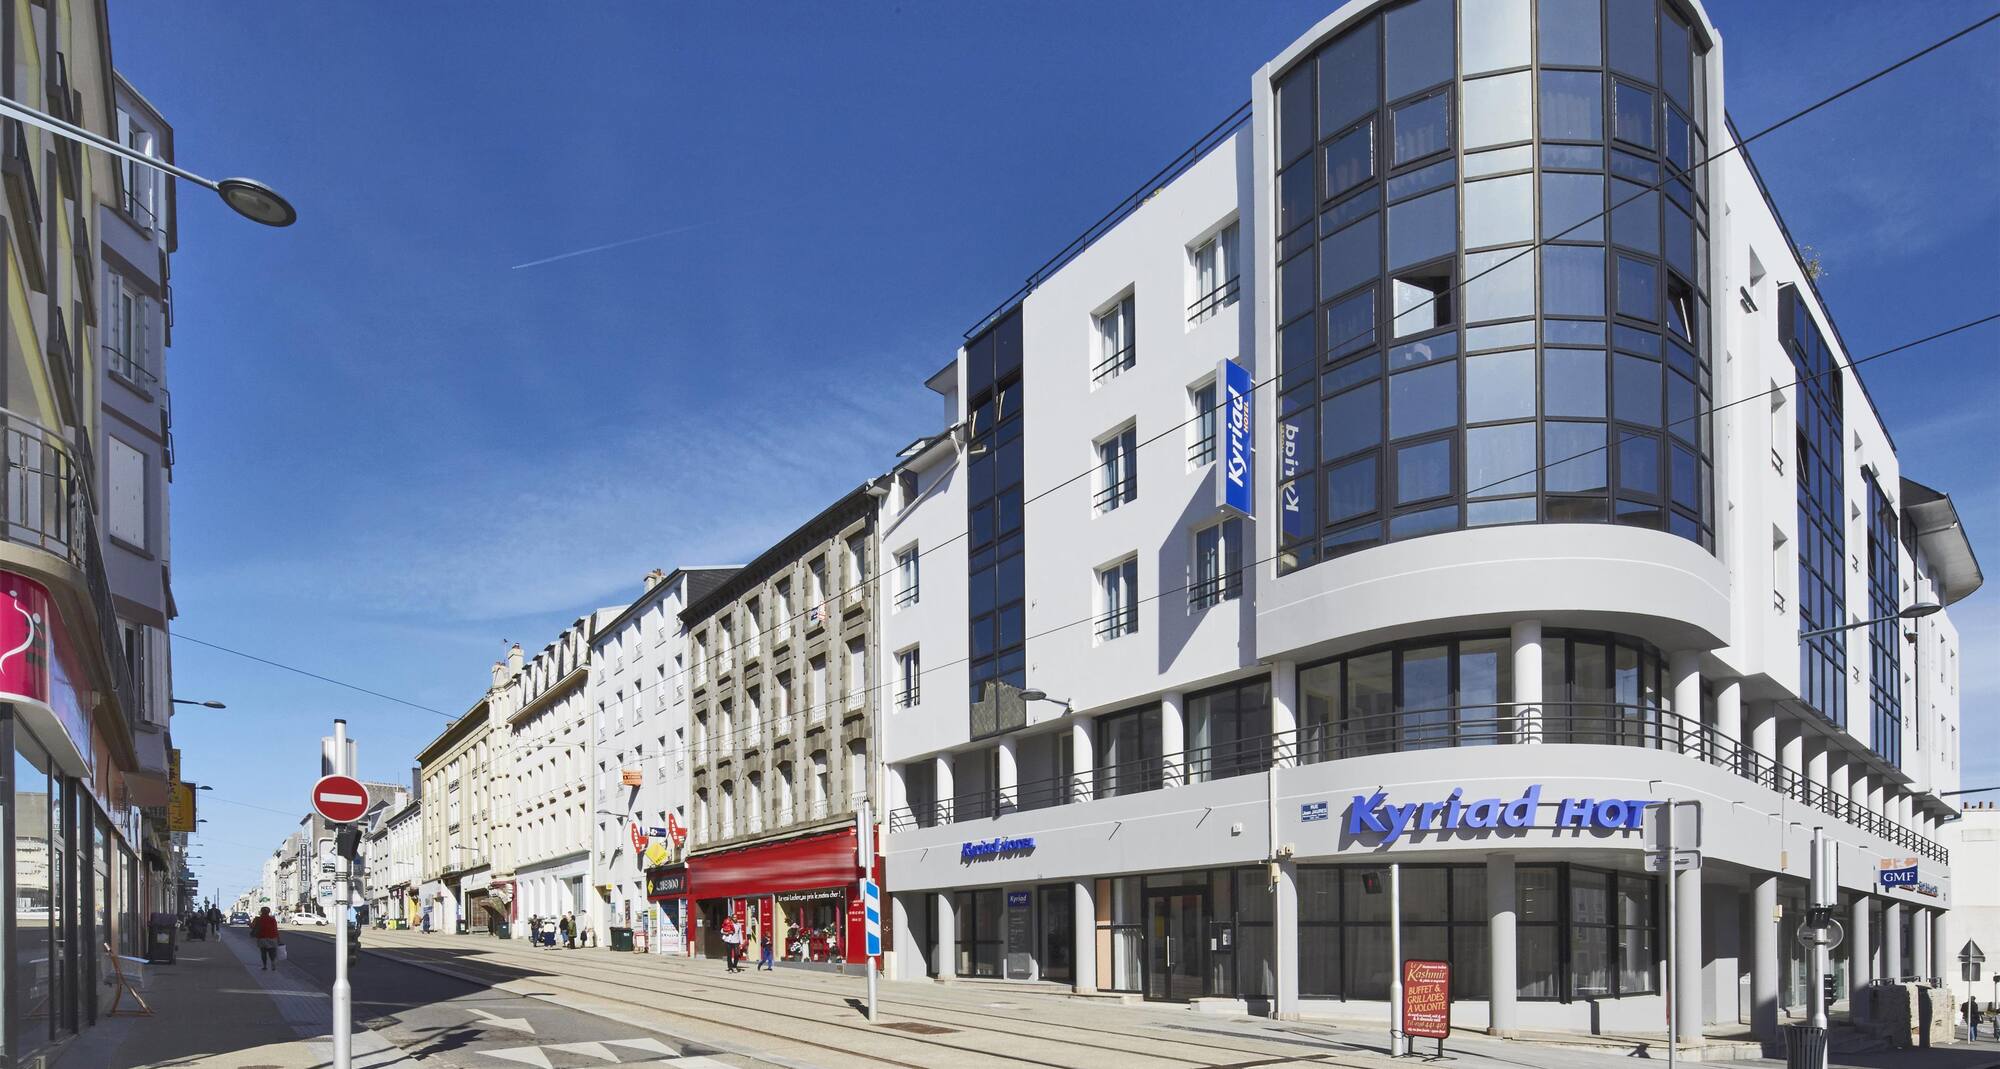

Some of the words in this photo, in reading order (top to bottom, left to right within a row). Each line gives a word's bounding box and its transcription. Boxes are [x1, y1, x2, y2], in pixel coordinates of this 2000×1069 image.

[1228, 384, 1248, 487] Kyriad
[1350, 785, 1542, 844] Kyriad
[1558, 798, 1655, 829] HOT
[961, 838, 1000, 859] Kyriad
[1883, 871, 1915, 882] GMF
[1407, 963, 1446, 982] Kashmir
[1408, 985, 1434, 995] BUFFET
[1434, 983, 1441, 993] &
[1407, 993, 1445, 1005] GRILLADES
